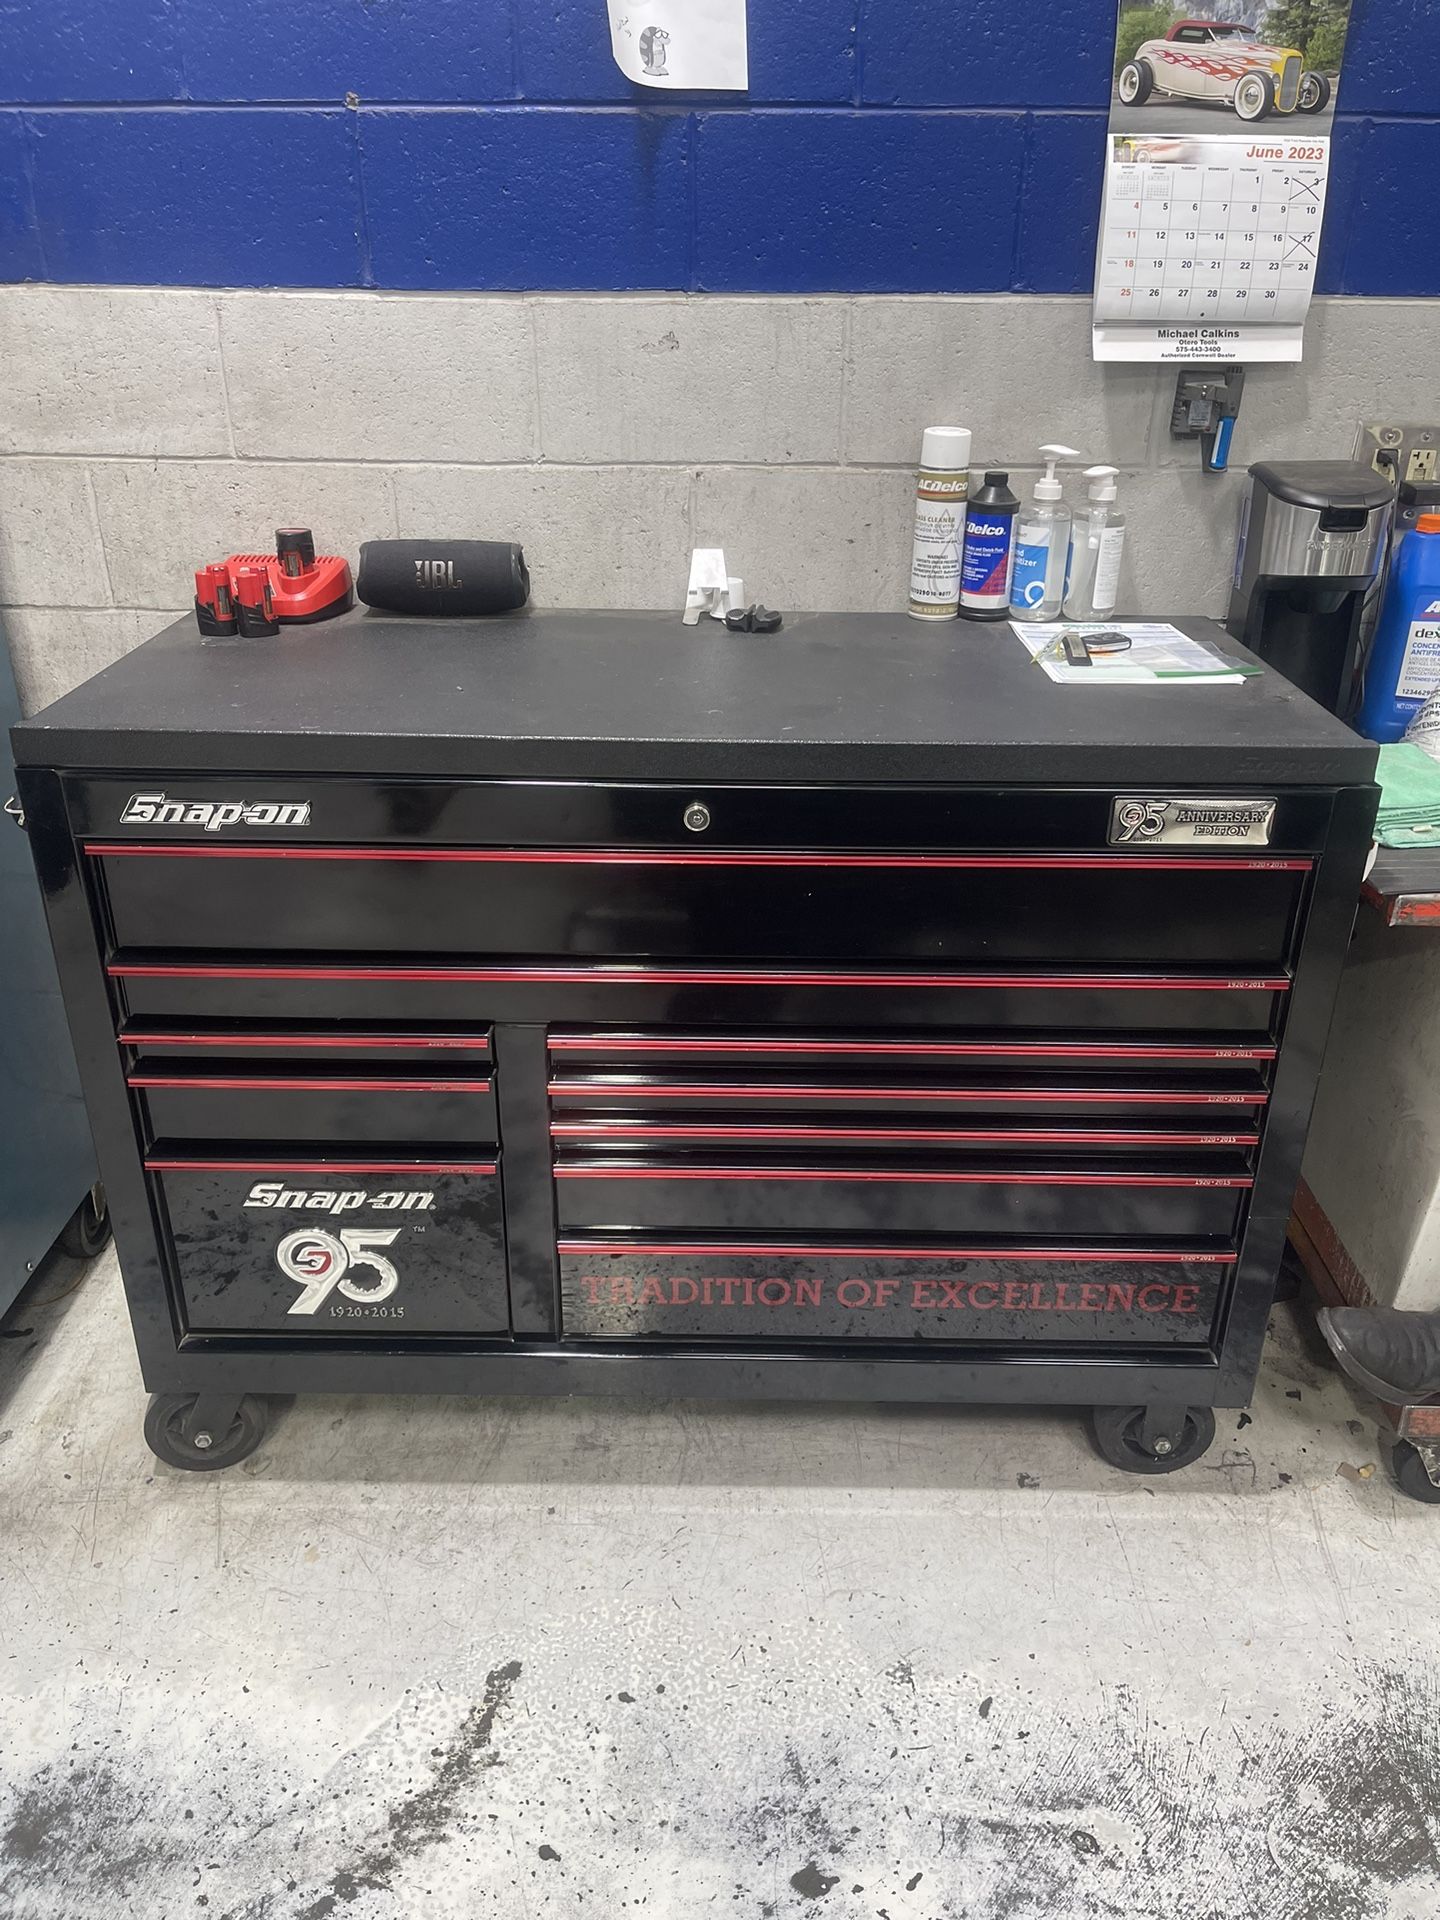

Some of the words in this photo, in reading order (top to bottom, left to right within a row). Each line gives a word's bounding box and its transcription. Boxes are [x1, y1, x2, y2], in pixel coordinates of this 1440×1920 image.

[1246, 145, 1284, 159] June
[1288, 146, 1324, 160] 2023
[1192, 203, 1198, 211] 6
[1244, 233, 1254, 241] 15
[1273, 234, 1283, 242] 16
[1303, 234, 1312, 242] 17
[1153, 260, 1163, 268] 19
[1211, 261, 1221, 269] 21
[1268, 262, 1279, 270] 23
[1298, 263, 1308, 271] 24
[1120, 288, 1131, 296] 25
[1178, 289, 1189, 297] 27
[1236, 290, 1247, 298] 29
[1157, 329, 1198, 338] Michael
[1201, 329, 1240, 338] Calkins
[918, 479, 968, 492] ACDelco
[966, 521, 1005, 535] Delco
[120, 794, 309, 830] Snap-on
[1117, 802, 1171, 841] 95
[1176, 810, 1269, 823] ANNIVERSARY
[1193, 825, 1249, 837] EDITION
[243, 1183, 435, 1214] Snap-on
[276, 1227, 402, 1315] 95
[579, 1275, 823, 1307] TRADITION
[837, 1278, 899, 1308] OF
[910, 1280, 1201, 1314] EXCELLENCE
